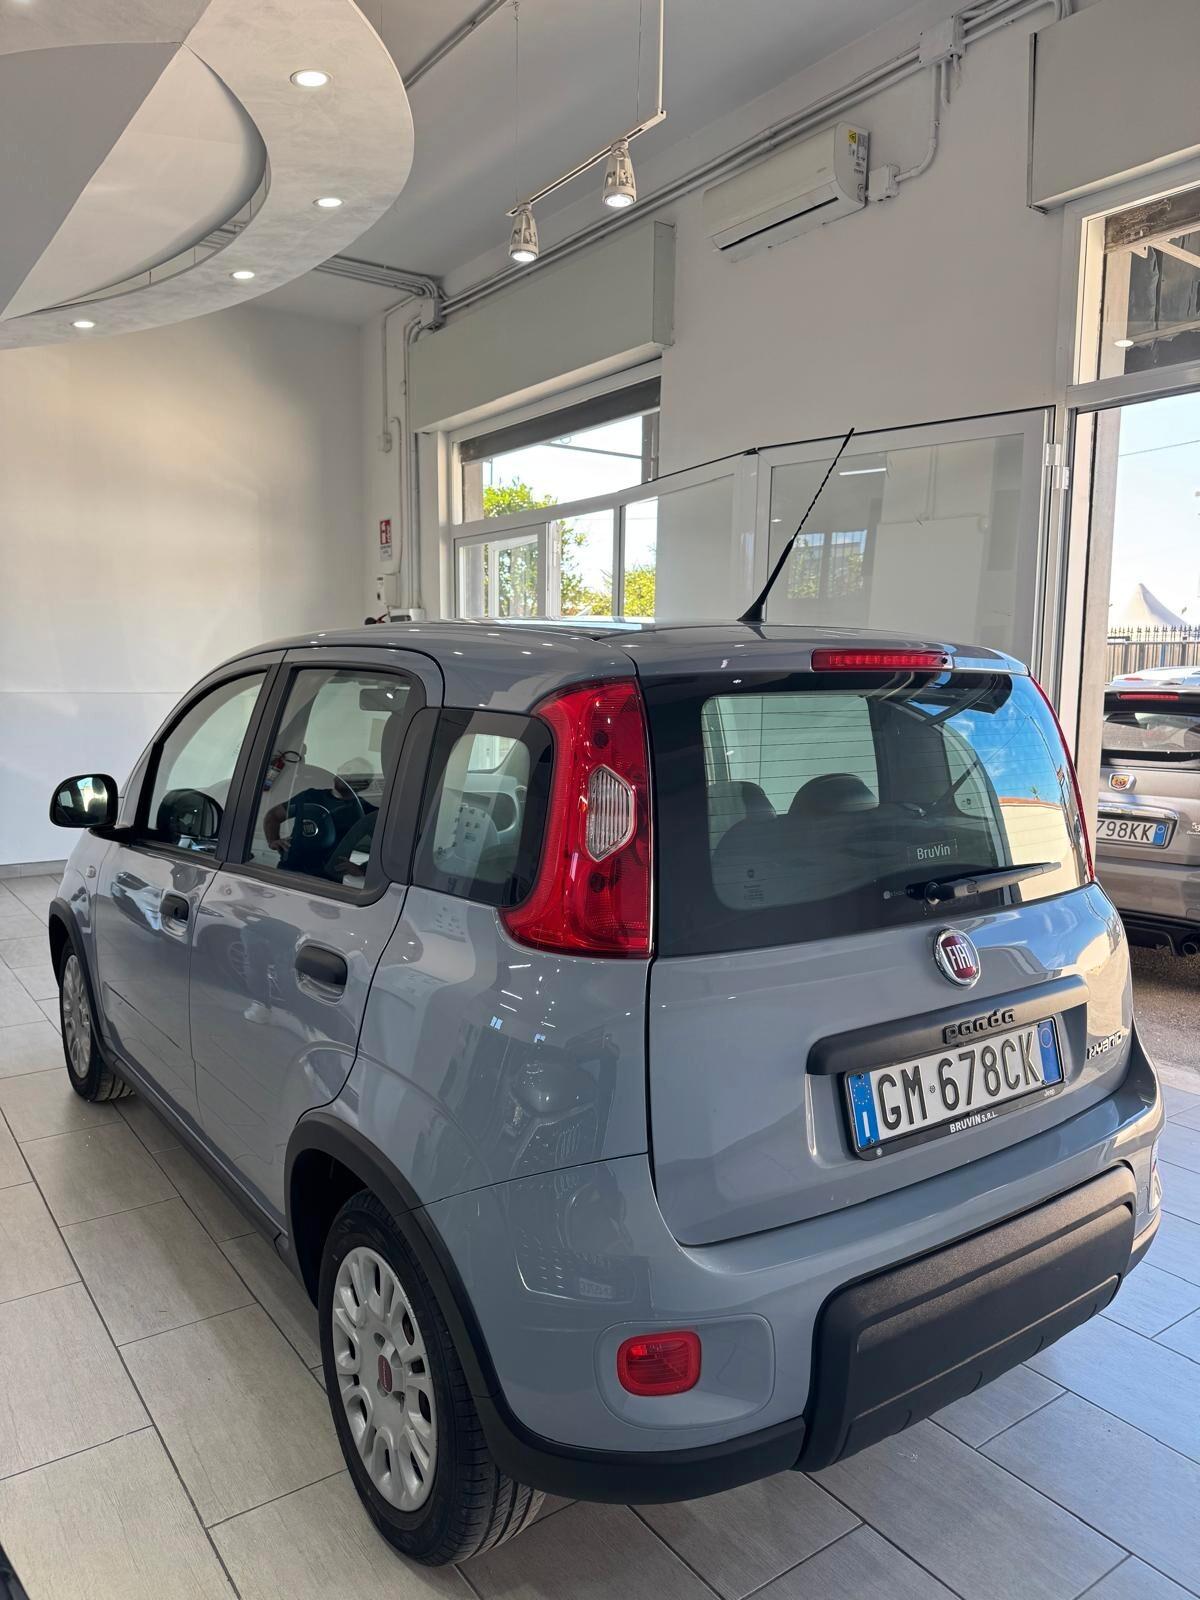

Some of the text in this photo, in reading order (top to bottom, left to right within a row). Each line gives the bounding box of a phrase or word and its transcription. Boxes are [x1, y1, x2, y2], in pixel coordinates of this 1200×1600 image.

[1096, 819, 1154, 842] 798KK
[916, 843, 951, 860] BruVin
[945, 943, 973, 971] FIAT
[877, 1065, 928, 1131] GM
[937, 1031, 1041, 1111] 678CK
[949, 1113, 981, 1134] BRUVIN
